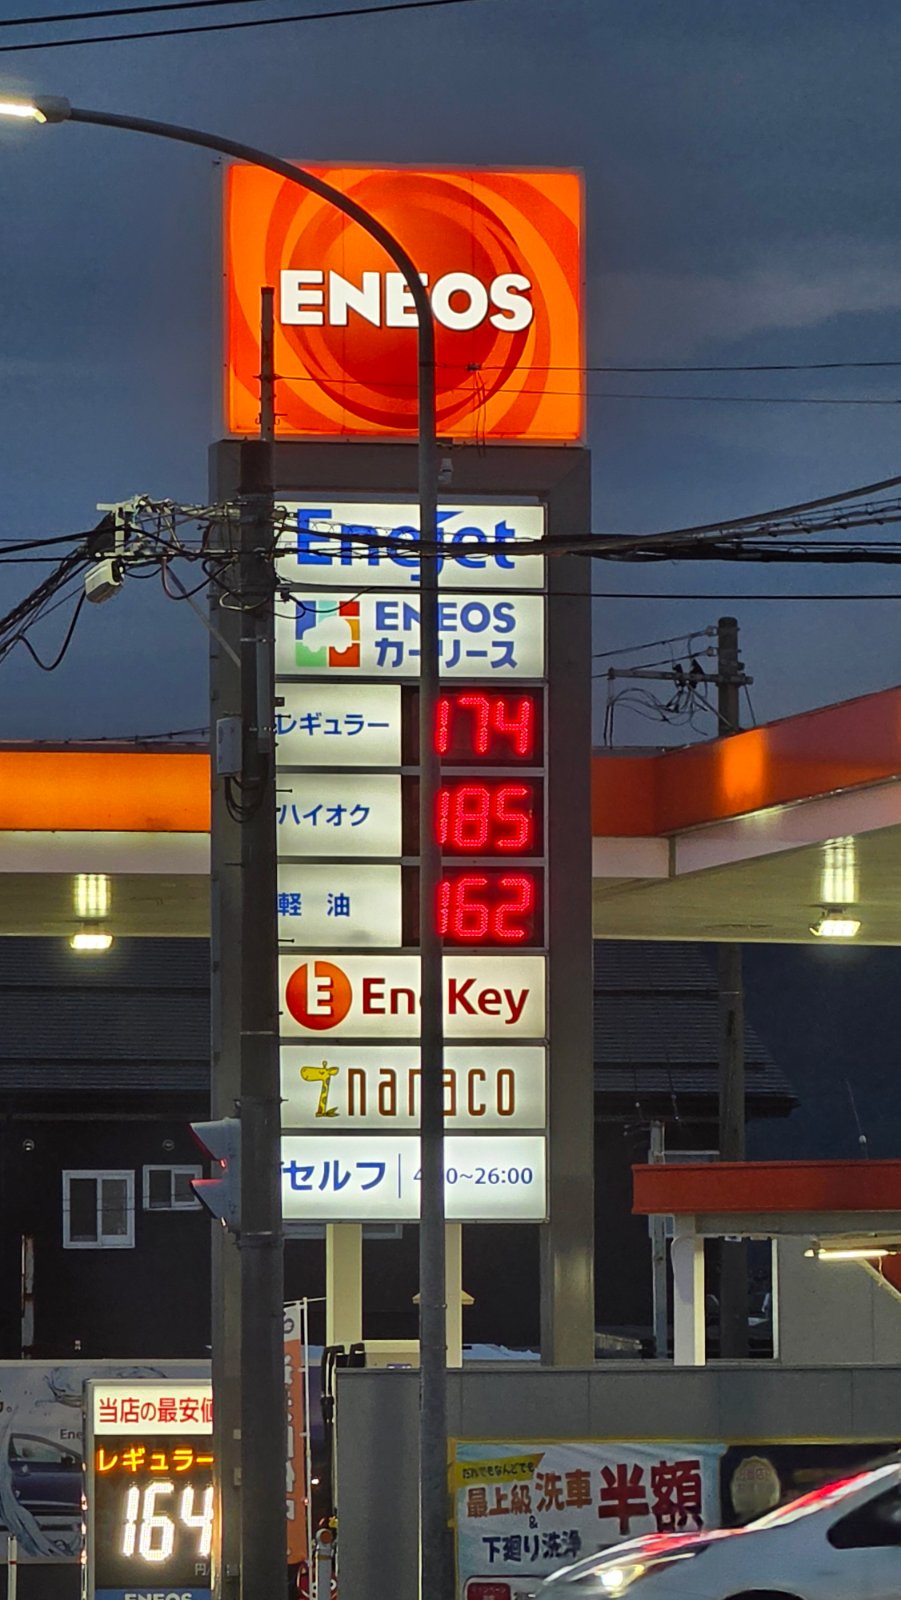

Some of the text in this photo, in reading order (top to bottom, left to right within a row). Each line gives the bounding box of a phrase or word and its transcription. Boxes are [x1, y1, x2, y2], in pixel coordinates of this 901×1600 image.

[279, 269, 534, 333] ENEOS
[375, 600, 516, 634] ENEOS
[276, 712, 390, 736] レギュラー
[436, 696, 531, 754] 174
[278, 804, 371, 827] ハイオク
[437, 787, 529, 848] 185
[438, 877, 531, 938] 162
[361, 977, 530, 1025] EnKey
[347, 1068, 515, 1117] nanaco
[281, 1160, 387, 1191] セルフ
[413, 1167, 533, 1185] 40~26:00
[98, 1448, 214, 1473] レギュラー
[121, 1481, 213, 1562] 164
[598, 1460, 702, 1535] 半額
